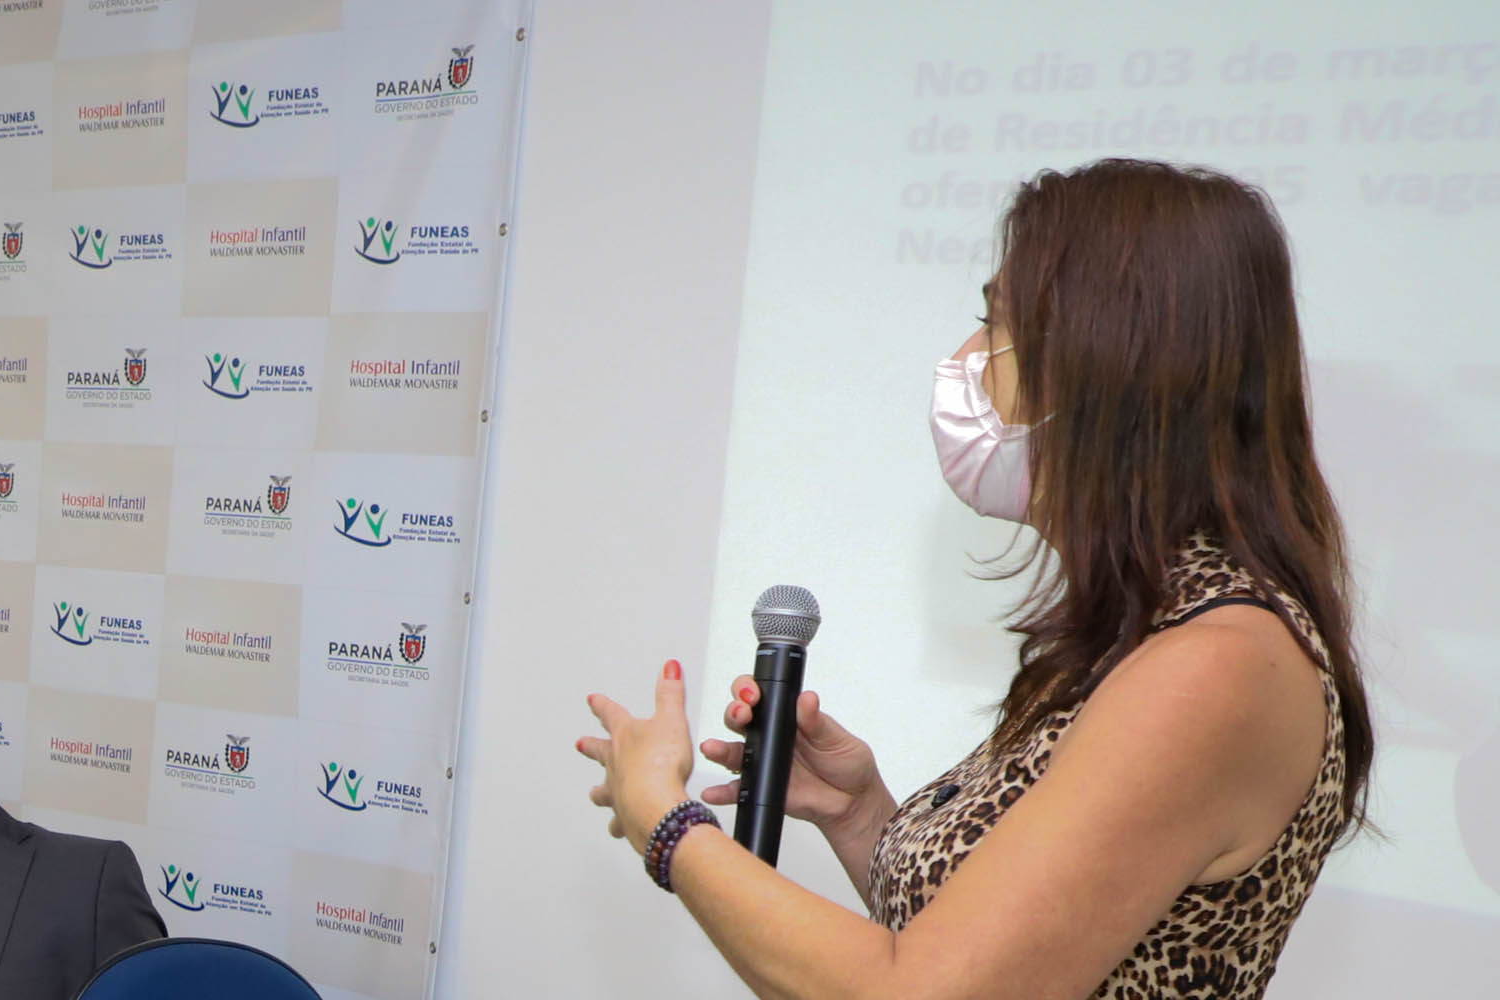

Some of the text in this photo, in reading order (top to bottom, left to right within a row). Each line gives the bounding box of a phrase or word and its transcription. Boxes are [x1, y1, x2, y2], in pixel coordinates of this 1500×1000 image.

[914, 59, 988, 97] No
[1012, 50, 1095, 92] dia
[1122, 48, 1194, 88] 03
[1220, 41, 1298, 84] de
[268, 88, 319, 102] FUNEAS
[376, 74, 442, 97] PARANÁ
[78, 99, 165, 120] Hospital Infantil
[374, 95, 479, 114] GOVERNO DO ESTADO
[121, 117, 165, 130] MONASTIER
[907, 93, 1500, 154] de Residência Méd
[120, 234, 164, 246] FUNEAS
[209, 226, 306, 246] Hospital Infantil
[410, 226, 469, 239] FUNEAS
[210, 244, 305, 257] WALDEMAR MONASTIER
[67, 368, 120, 385] PARANÁ
[259, 365, 306, 378] FUNEAS
[350, 359, 461, 378] Hospital Infantil
[349, 378, 458, 391] WALDEMAR MONASTIER
[65, 390, 152, 402] GOVERNO DO ESTADO
[61, 492, 146, 511] Hospital Infantil
[205, 496, 262, 513] PARANÁ
[61, 508, 145, 523] WALDEMAR MONASTIER
[203, 516, 292, 530] GOVERNO DO ESTADO
[402, 513, 454, 528] FUNEAS
[100, 616, 143, 631] FUNEAS
[185, 628, 272, 650] Hospital Infantil
[185, 644, 271, 663] WALDEMAR MONASTIER
[328, 641, 394, 662] PARANÁ
[327, 661, 429, 681] GOVERNO DO ESTADO
[50, 736, 133, 762] Hospital Infantil
[50, 752, 132, 774] WALDEMAR MONASTIER
[166, 749, 221, 770] PARANÁ
[164, 768, 203, 783] GOVERNO
[204, 774, 218, 785] DO
[219, 775, 256, 790] ESTADO
[376, 781, 422, 798] FUNEAS
[213, 882, 264, 901] FUNEAS
[316, 901, 404, 933] Hospital Infantil
[316, 917, 403, 946] WALDEMAR MONASTIER
